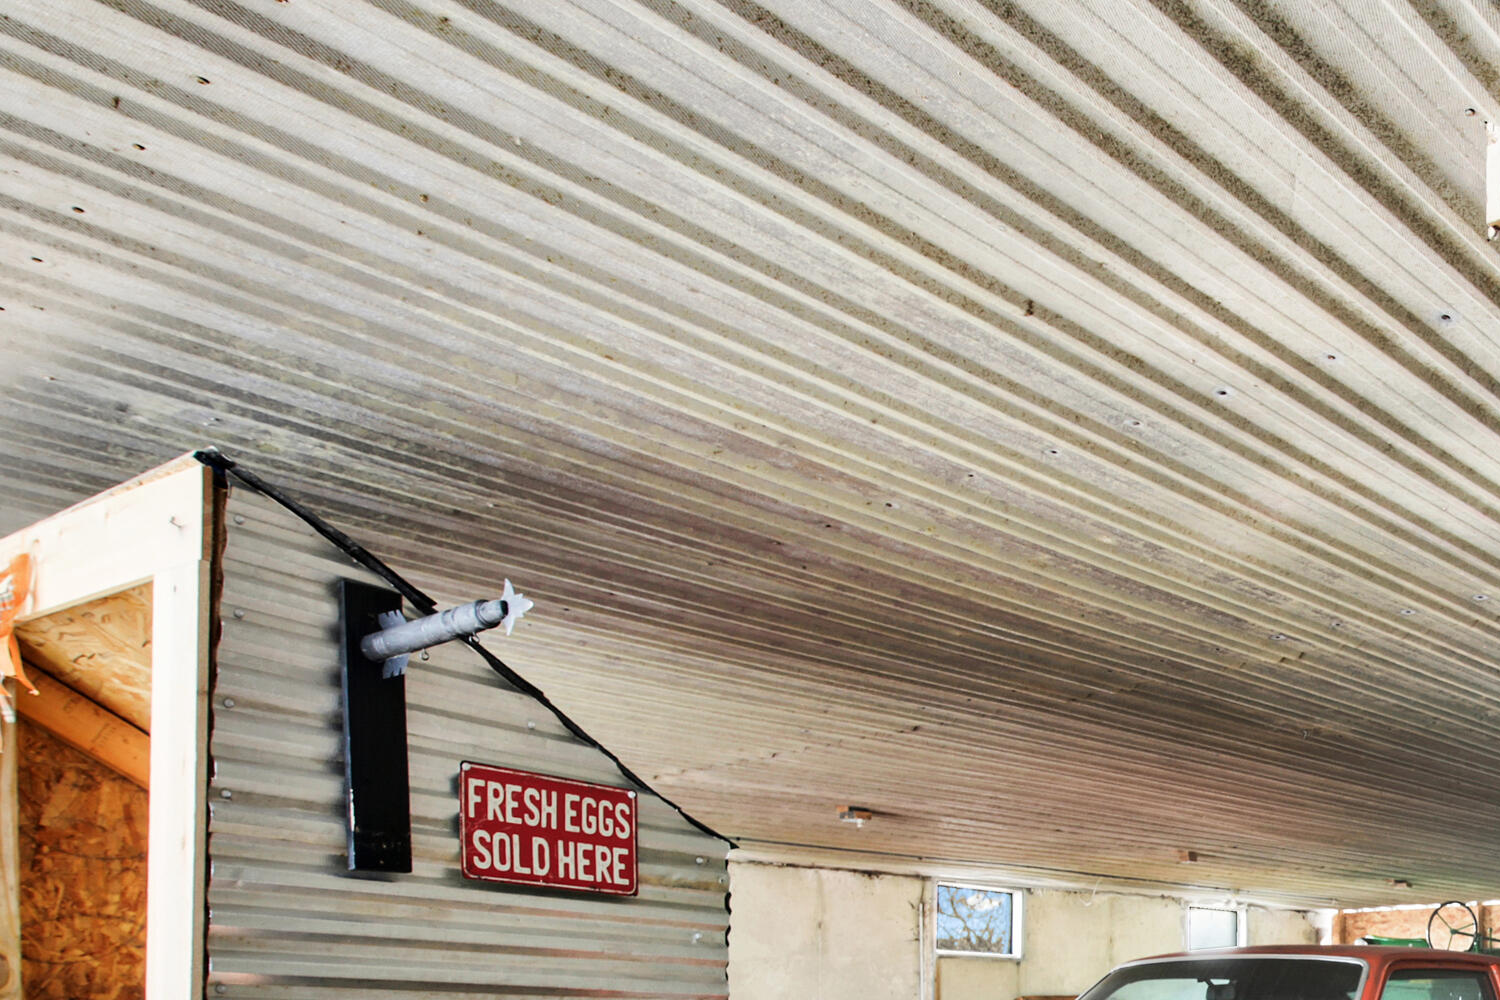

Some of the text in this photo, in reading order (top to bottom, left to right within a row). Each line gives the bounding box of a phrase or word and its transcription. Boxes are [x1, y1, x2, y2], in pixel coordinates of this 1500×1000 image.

[468, 779, 631, 839] FRESH EGGS
[472, 829, 629, 885] SOLD HERE
